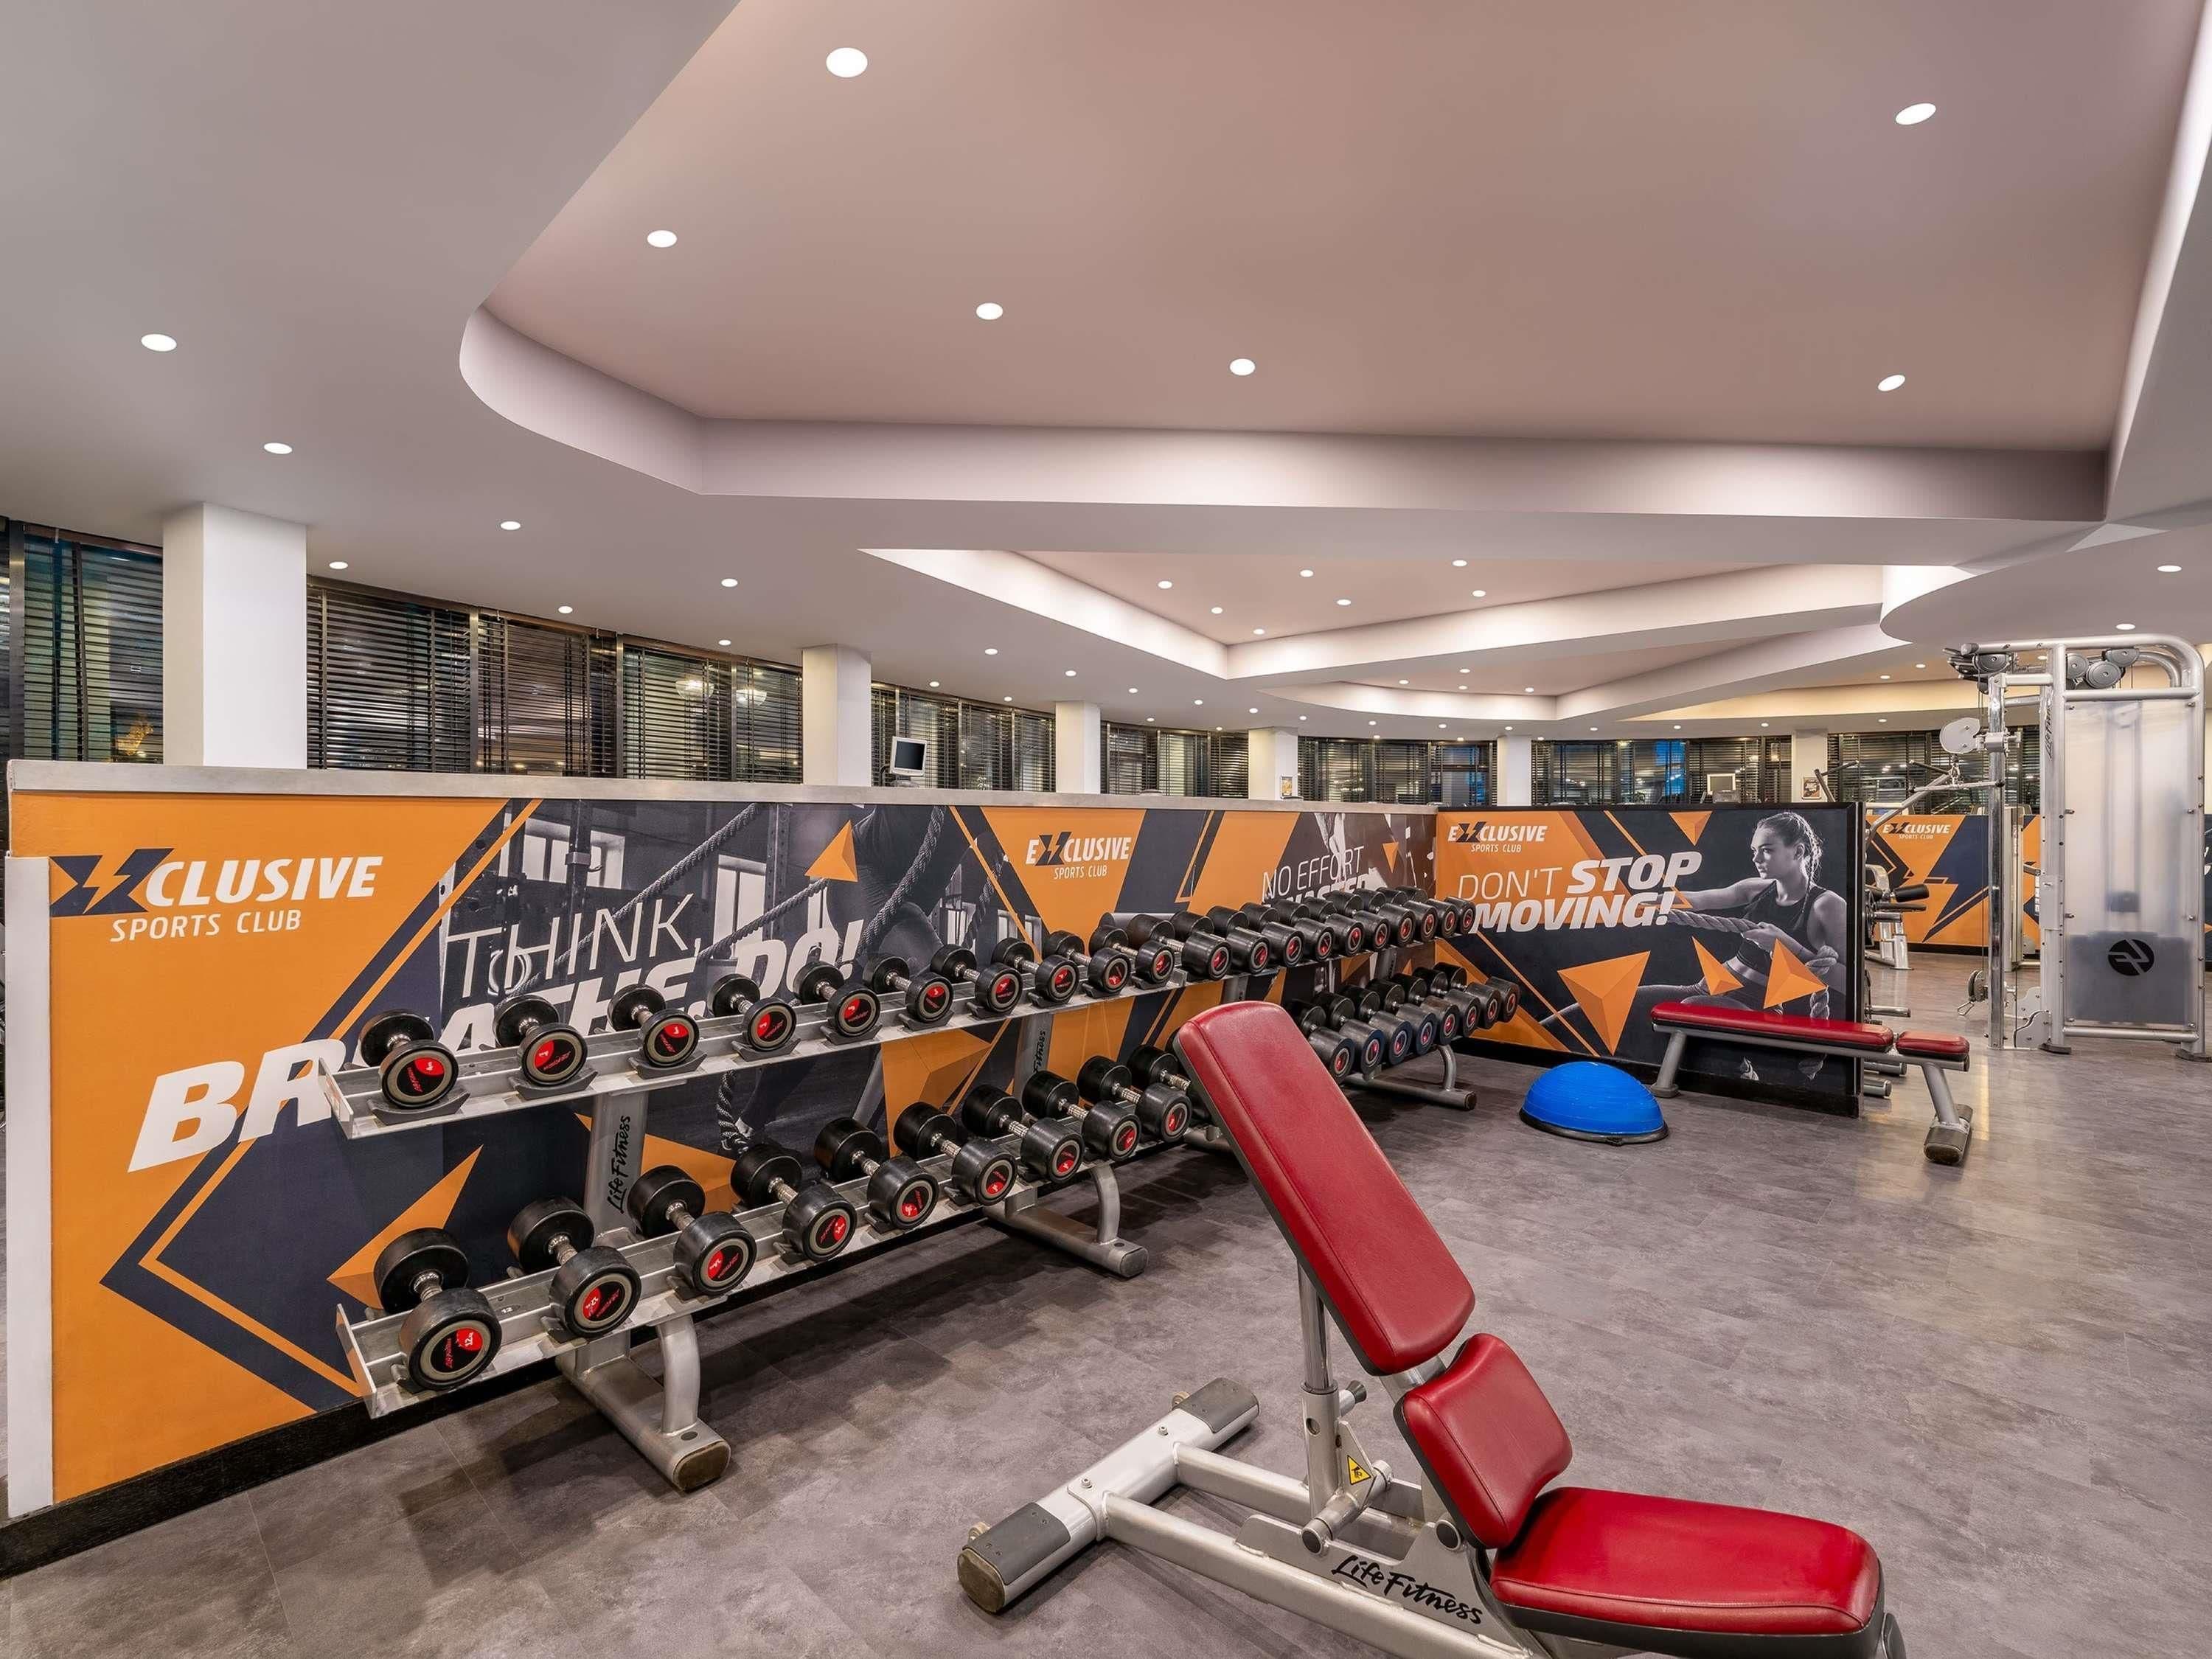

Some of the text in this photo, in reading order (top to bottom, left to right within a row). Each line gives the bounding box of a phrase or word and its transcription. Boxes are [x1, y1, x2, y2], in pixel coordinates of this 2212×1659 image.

[1447, 821, 1548, 843] EXCLUSIVE
[1882, 822, 1952, 835] EXCLUSIVE
[1025, 831, 1133, 866] EXCLUSIVE
[1471, 844, 1522, 853] SPORTS CLUB
[1053, 864, 1107, 880] SPORTS CLUB
[1262, 846, 1365, 904] NO EFFORT
[1457, 851, 1703, 902] DON'T STOP
[108, 909, 302, 943] SPORTS CLUB
[1468, 891, 1677, 934] MOVING!
[445, 893, 701, 998] THINK,
[607, 1116, 631, 1214] Life Fitness
[1330, 1554, 1483, 1625] Life Fitness
